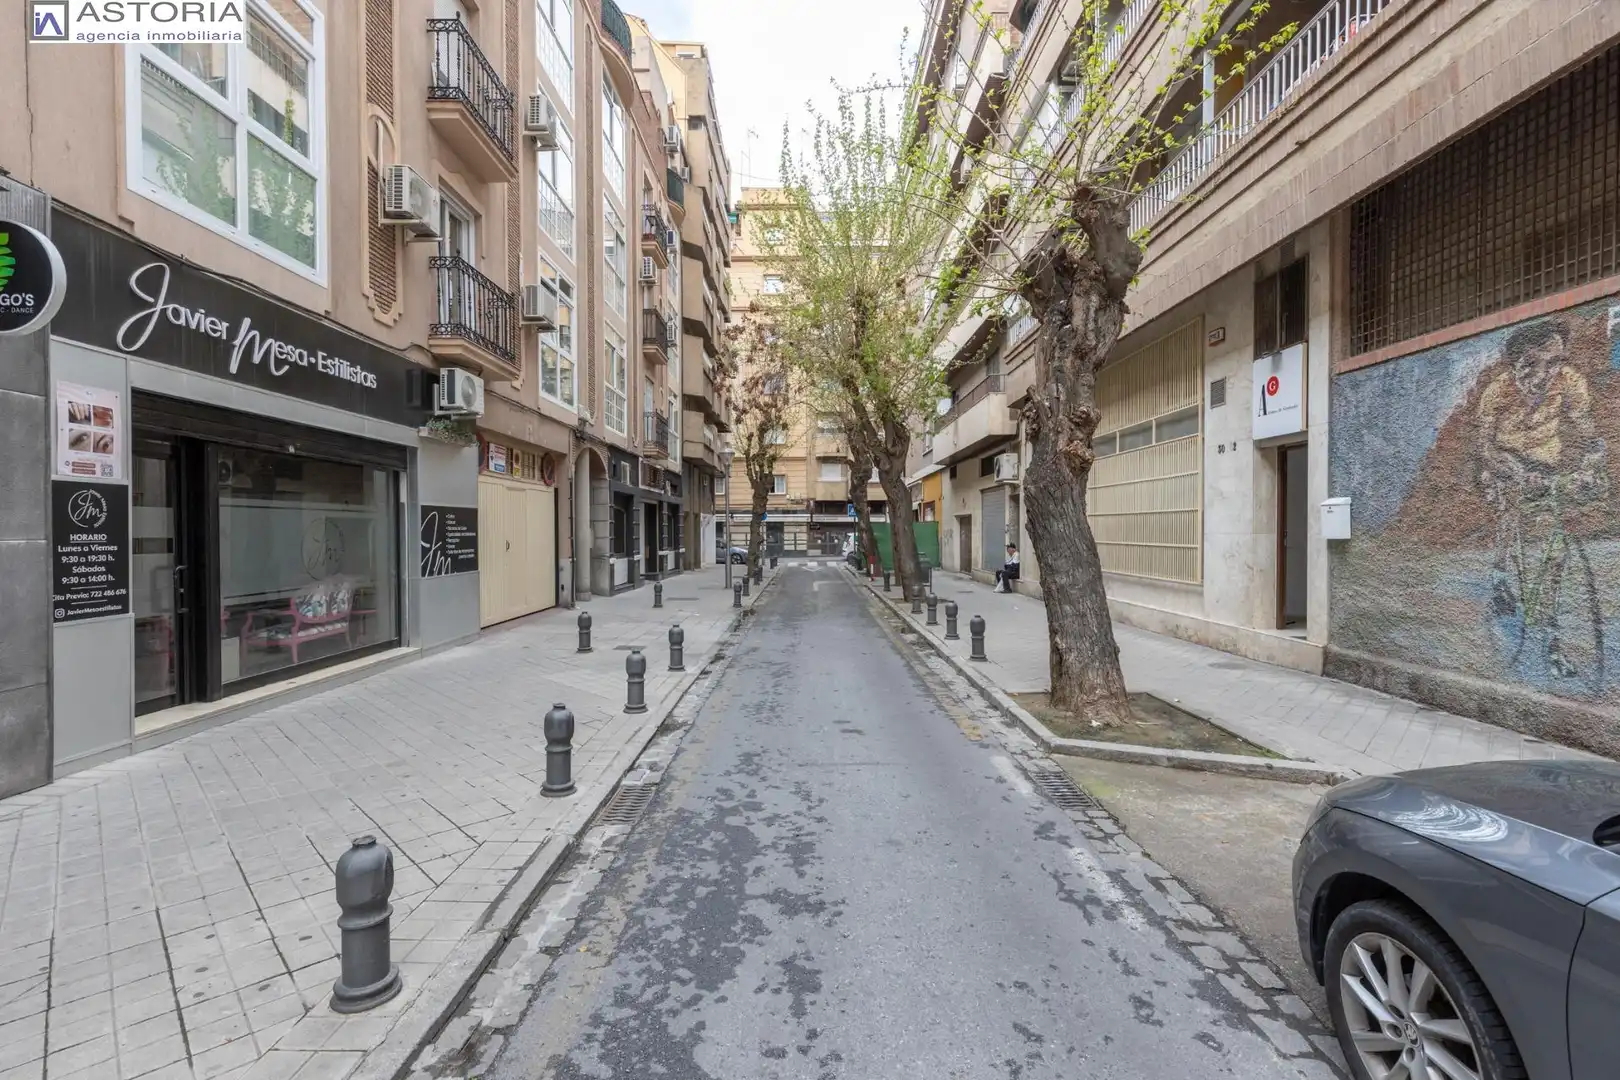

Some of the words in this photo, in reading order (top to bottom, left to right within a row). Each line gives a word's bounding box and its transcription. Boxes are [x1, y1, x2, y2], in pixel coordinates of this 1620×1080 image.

[0, 292, 34, 306] GO'S
[117, 262, 229, 351] Javier
[229, 317, 309, 376] Mesa
[317, 351, 377, 389] Estilistas
[72, 565, 106, 573] Sábados
[66, 592, 90, 600] Previa:
